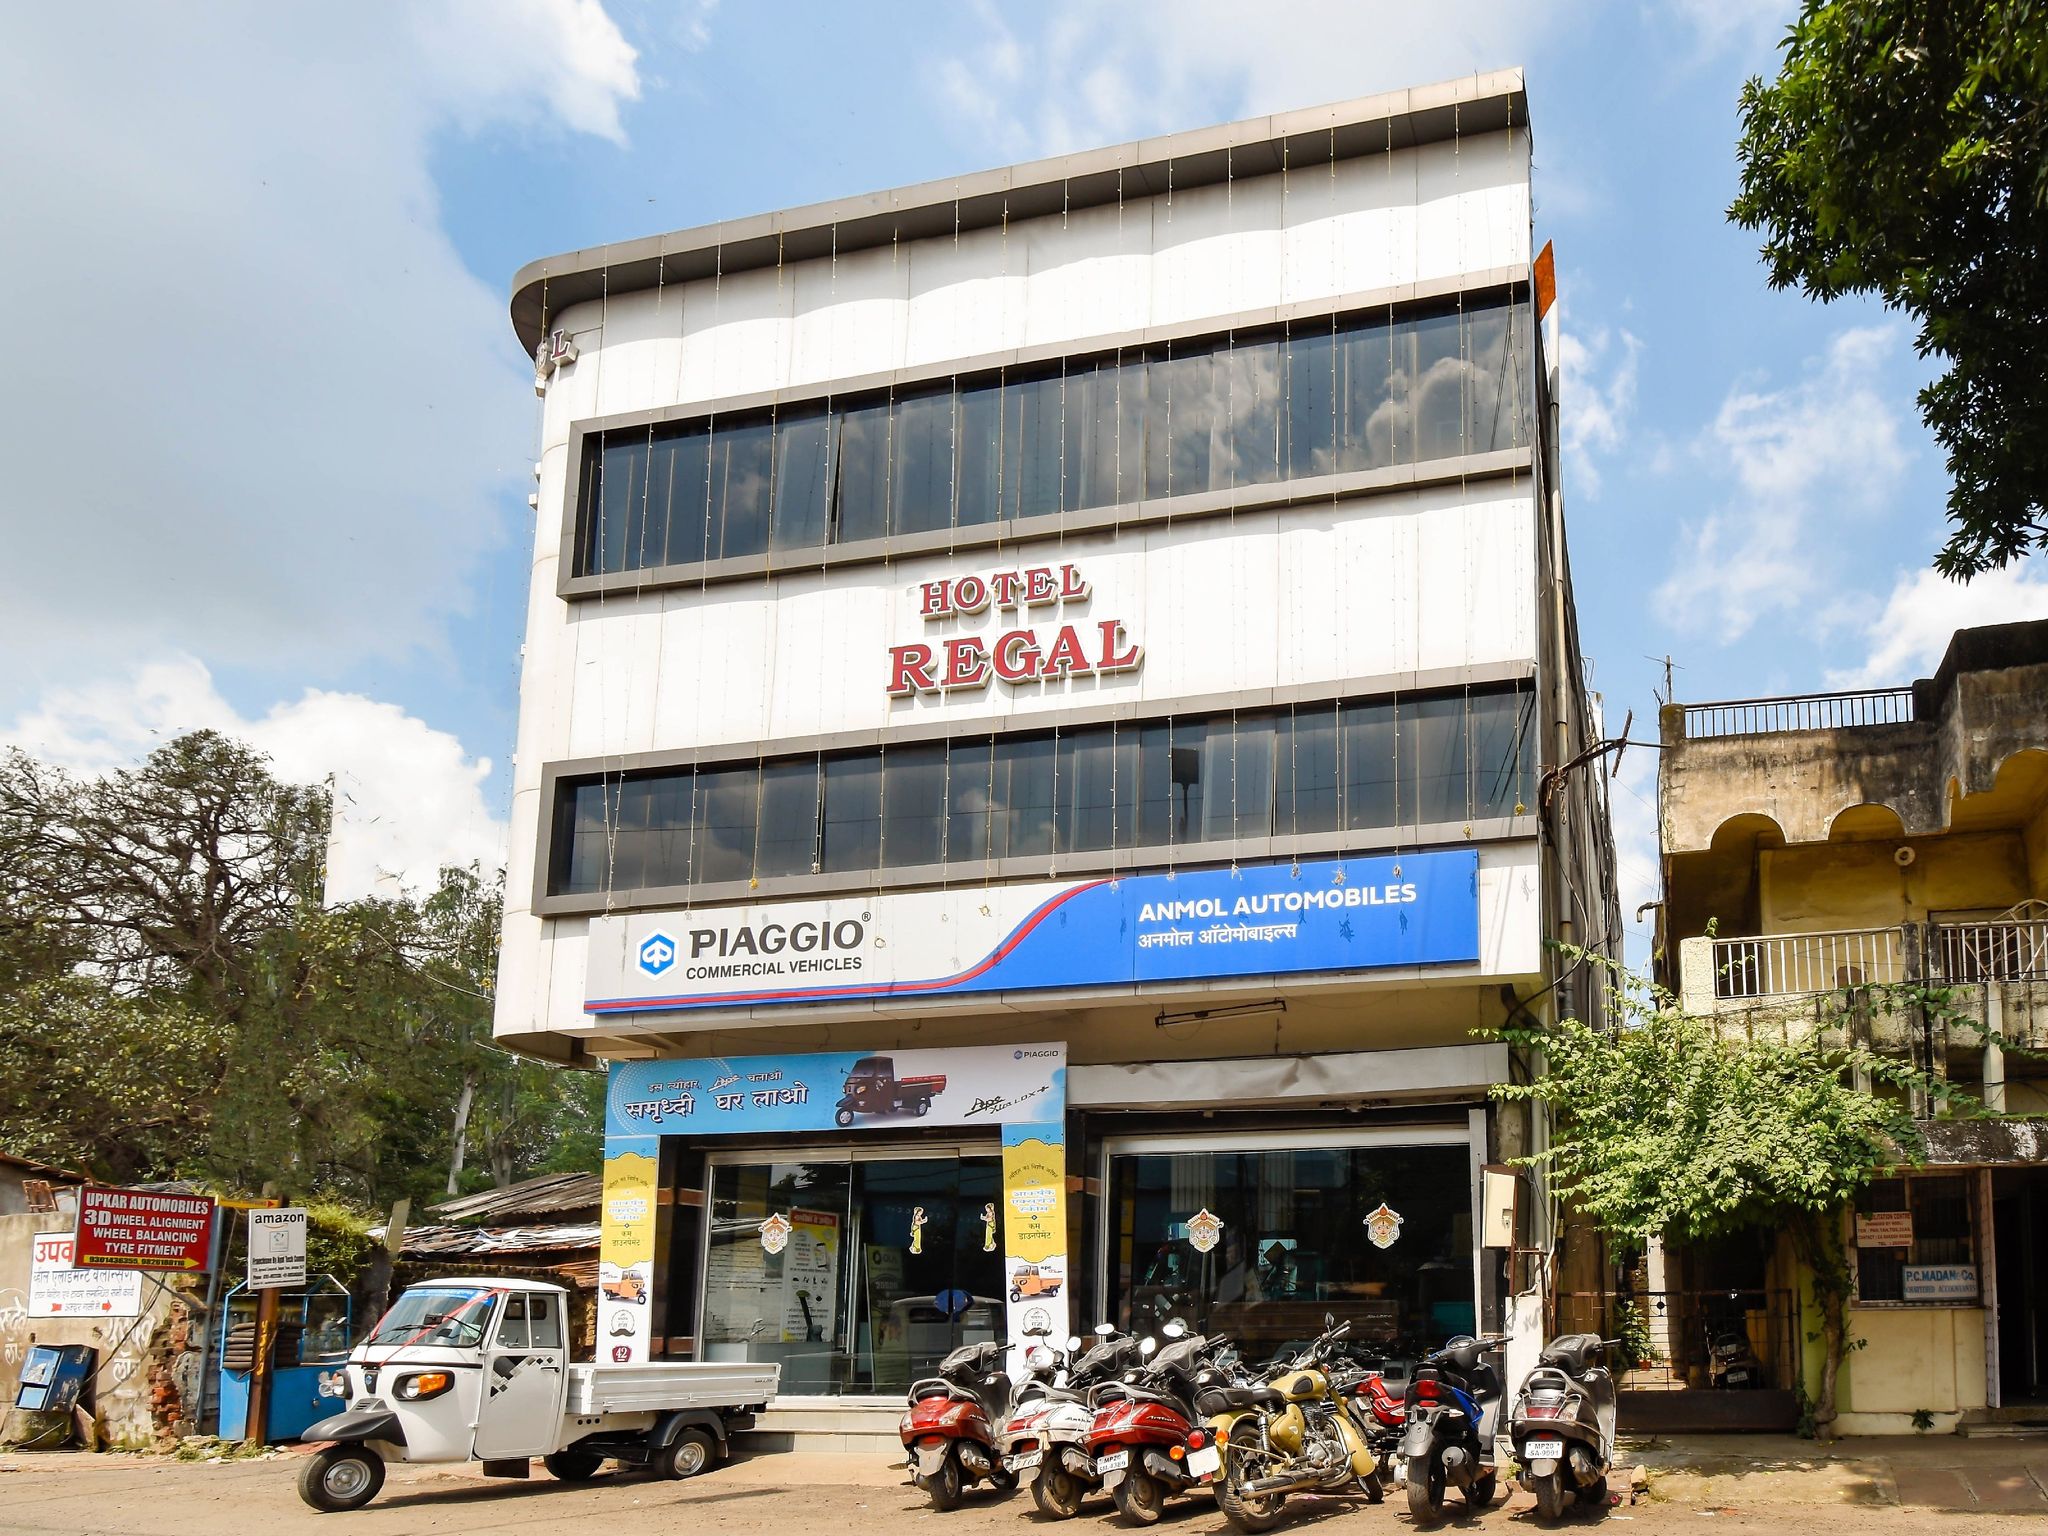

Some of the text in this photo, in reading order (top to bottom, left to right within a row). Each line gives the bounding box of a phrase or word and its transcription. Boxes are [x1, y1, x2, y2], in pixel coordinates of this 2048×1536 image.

[919, 563, 1087, 615] HOTEL
[886, 619, 1140, 692] REGAL
[1138, 883, 1417, 922] ANMOL AUTOMOBILES
[689, 919, 865, 959] PIAGGIO
[1138, 922, 1298, 949] अनमोल ऑटोमोबाइल्स
[686, 956, 862, 980] COMMERCIAL VEHICLES
[1023, 1050, 1059, 1058] PIAGGIO
[714, 1092, 744, 1111] घर
[752, 1081, 808, 1108] लाओ
[86, 1193, 209, 1215] UPKAR AUTOMOBILES
[84, 1209, 206, 1230] 3D WHEEL ALIGNMENT
[255, 1213, 304, 1224] amazon
[93, 1227, 198, 1243] WHEEL BALANCING
[105, 1242, 185, 1256] TYRE FITMENT
[615, 1347, 628, 1359] 42
